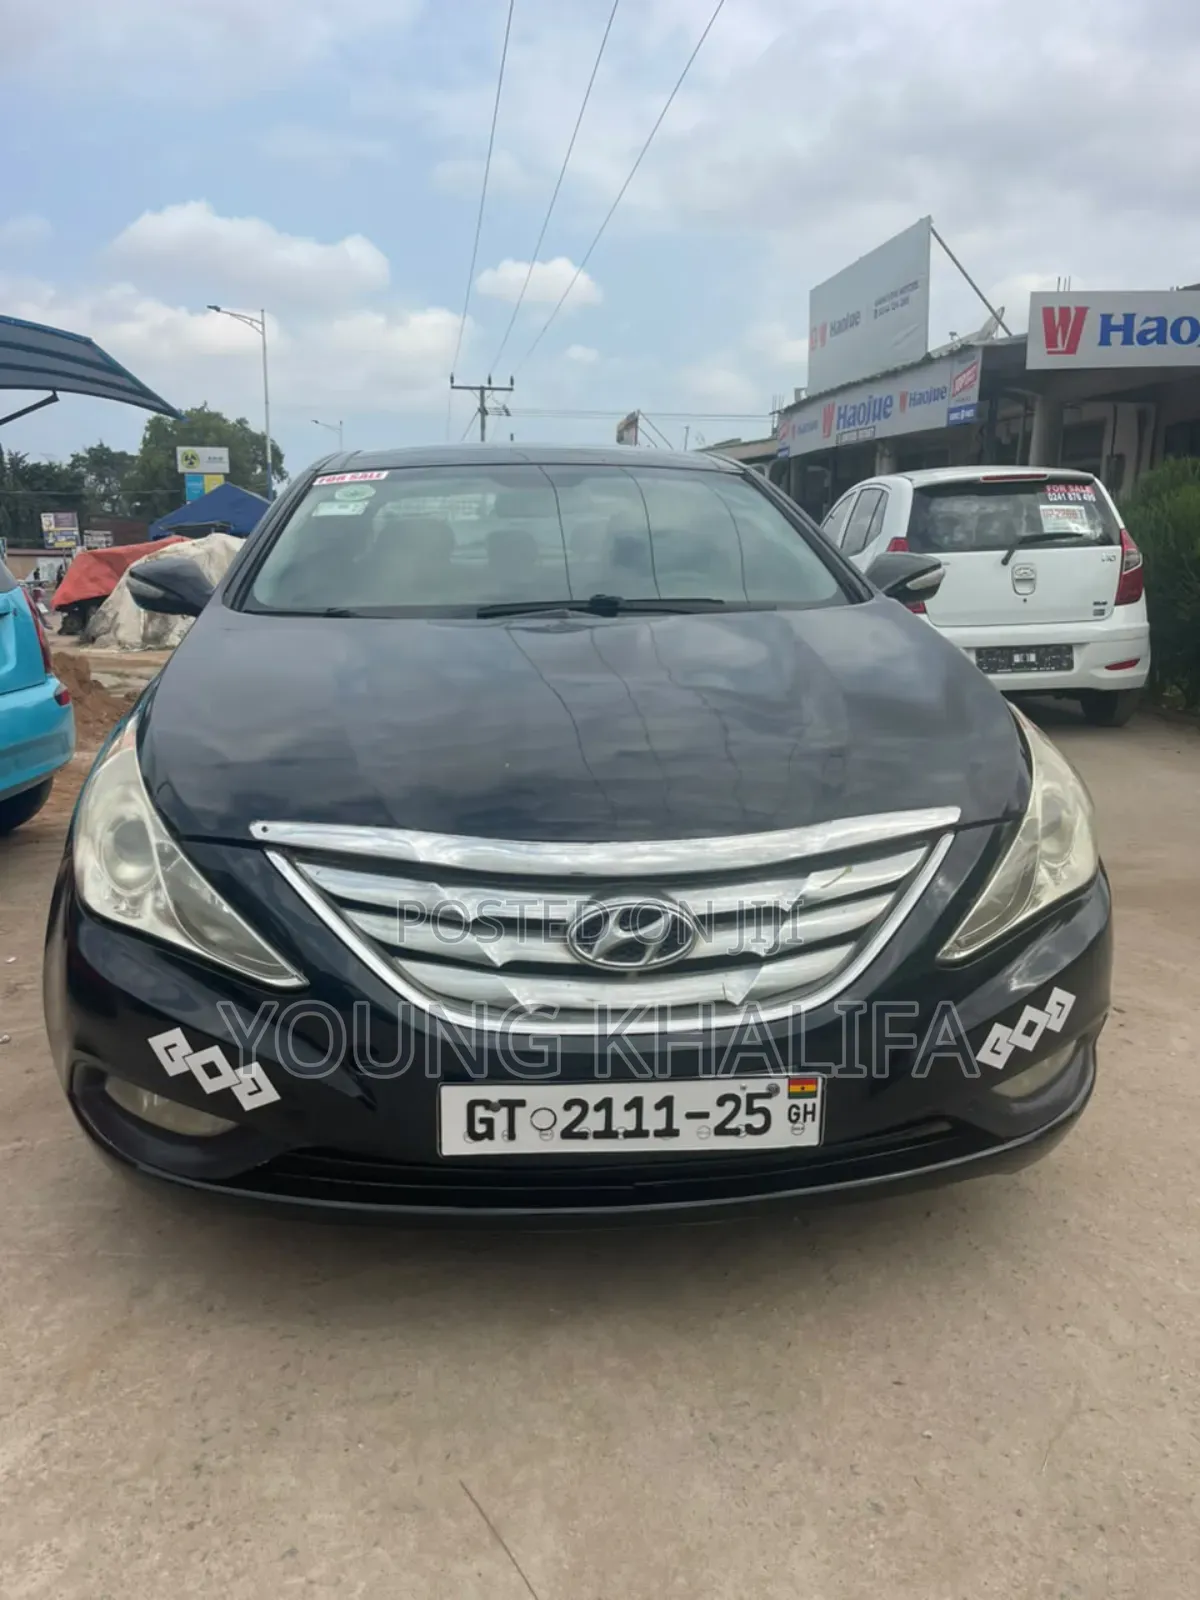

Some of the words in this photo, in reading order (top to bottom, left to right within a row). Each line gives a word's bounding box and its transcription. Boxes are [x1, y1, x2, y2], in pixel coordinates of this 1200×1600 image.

[1098, 313, 1200, 347] Hao
[836, 394, 894, 432] Haojue
[908, 385, 948, 408] Haojue
[466, 1099, 526, 1141] GT
[560, 1092, 772, 1139] 2111-25
[787, 1102, 816, 1124] GH
